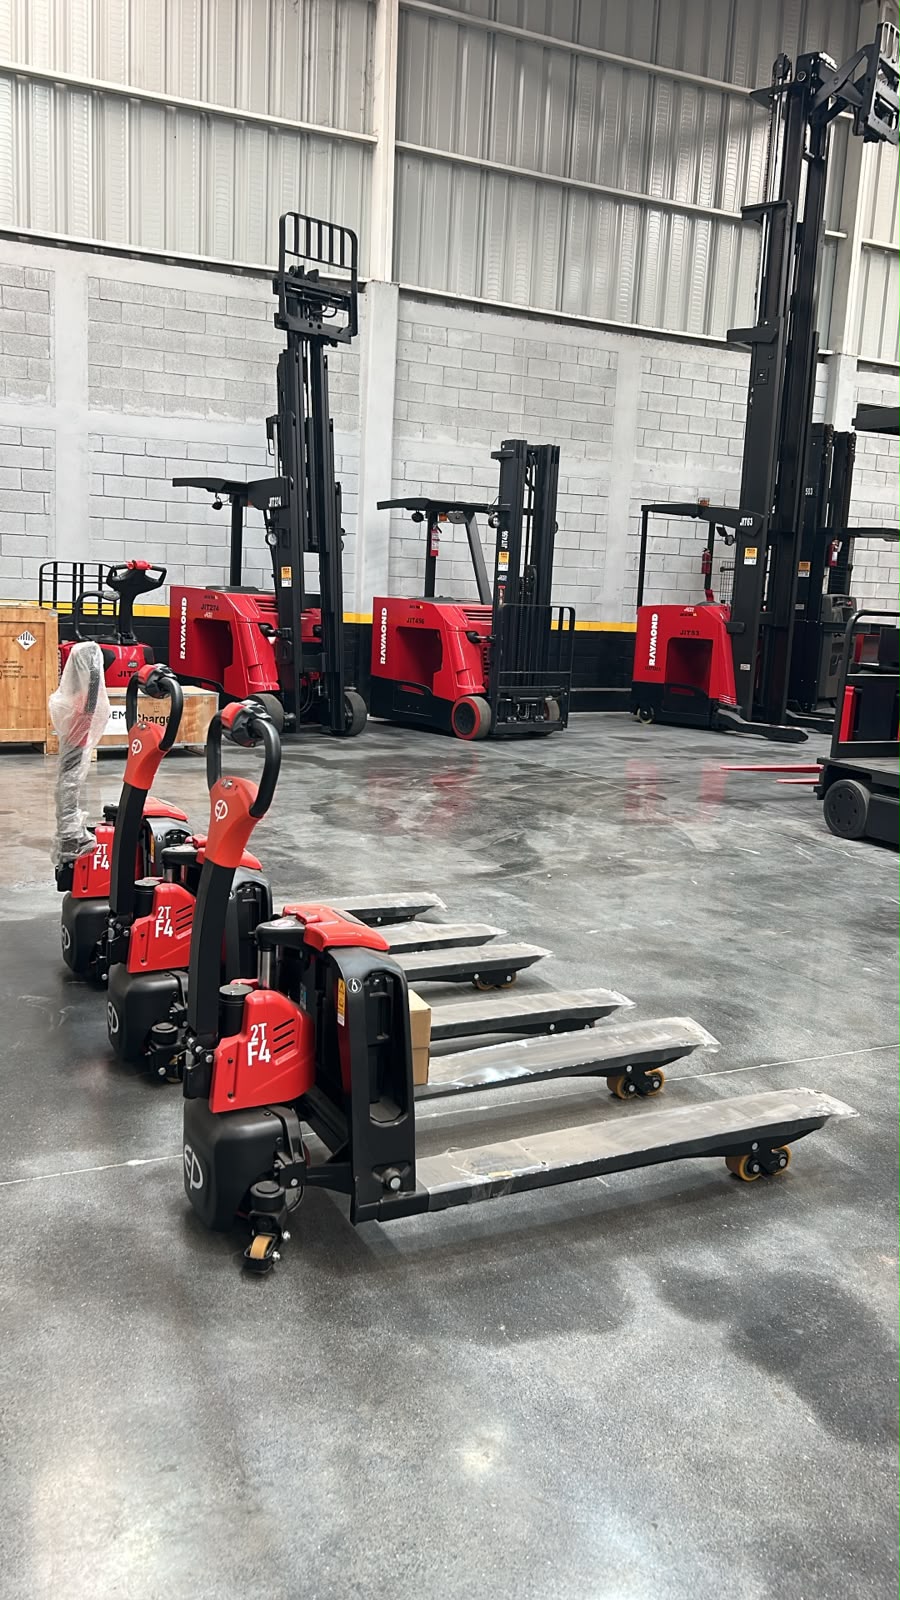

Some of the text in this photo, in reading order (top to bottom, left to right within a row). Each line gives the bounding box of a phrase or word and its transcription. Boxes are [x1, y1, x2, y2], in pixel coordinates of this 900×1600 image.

[180, 597, 188, 660] RAYMOND
[380, 607, 388, 665] RAYMOND
[648, 613, 659, 667] RAYMOND
[96, 843, 108, 855] 2T
[93, 854, 110, 870] F4
[157, 905, 172, 919] 2T
[155, 918, 174, 938] F4
[250, 1022, 268, 1042] 2T
[247, 1039, 272, 1067] F4
